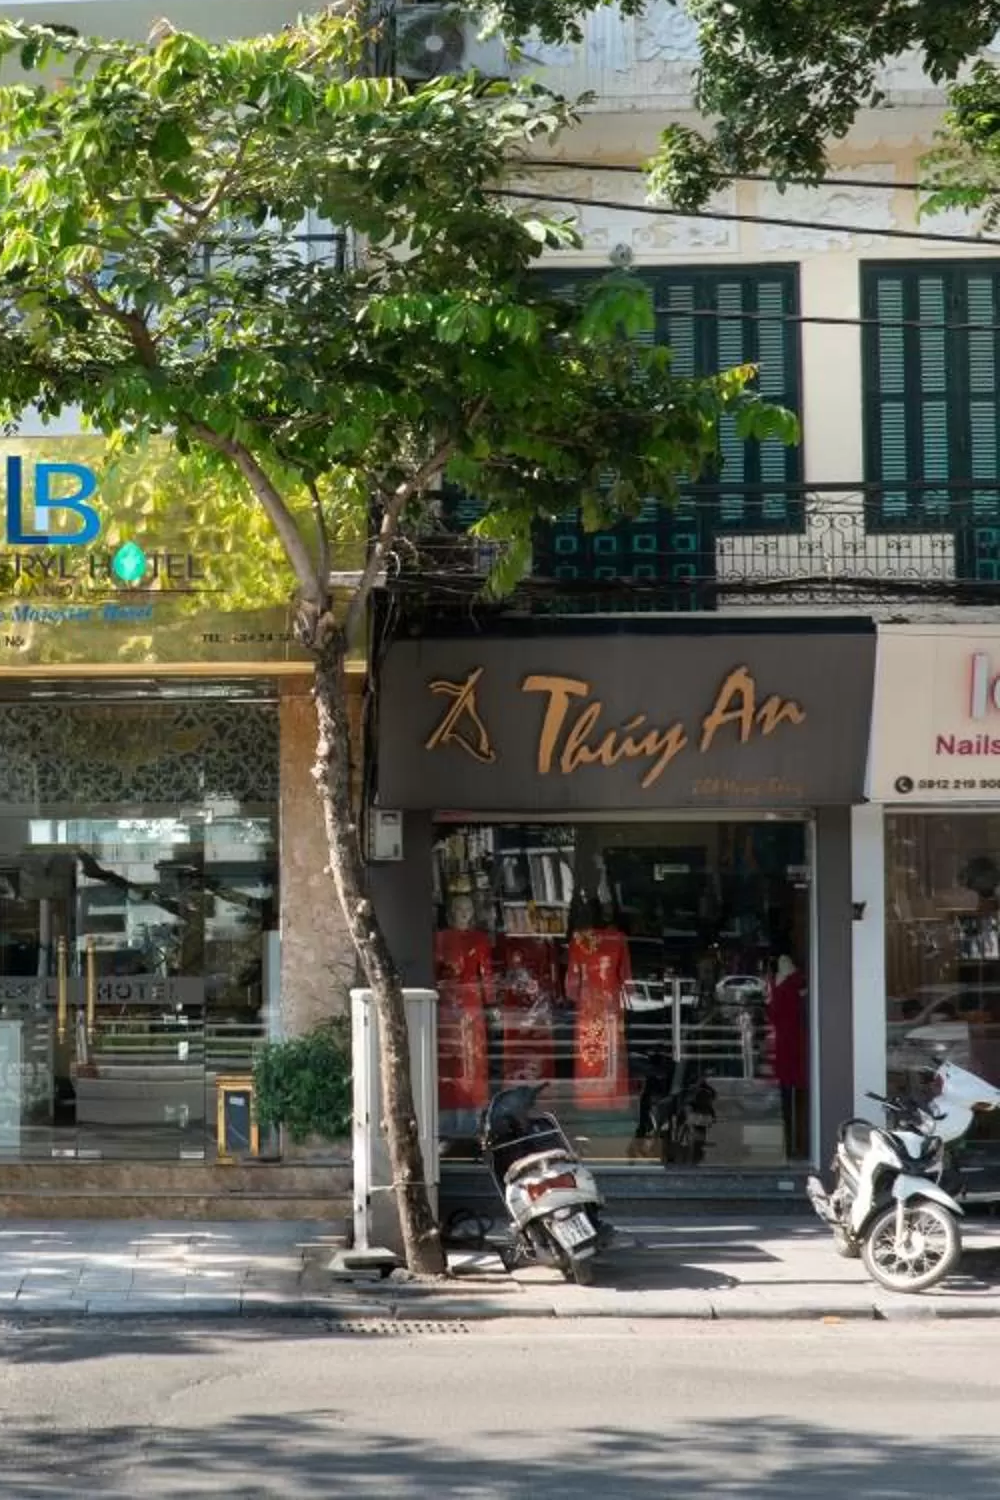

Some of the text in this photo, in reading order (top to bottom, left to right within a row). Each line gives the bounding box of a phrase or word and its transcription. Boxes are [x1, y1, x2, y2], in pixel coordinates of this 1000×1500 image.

[523, 665, 807, 789] Thúy An
[935, 733, 1000, 756] Nails
